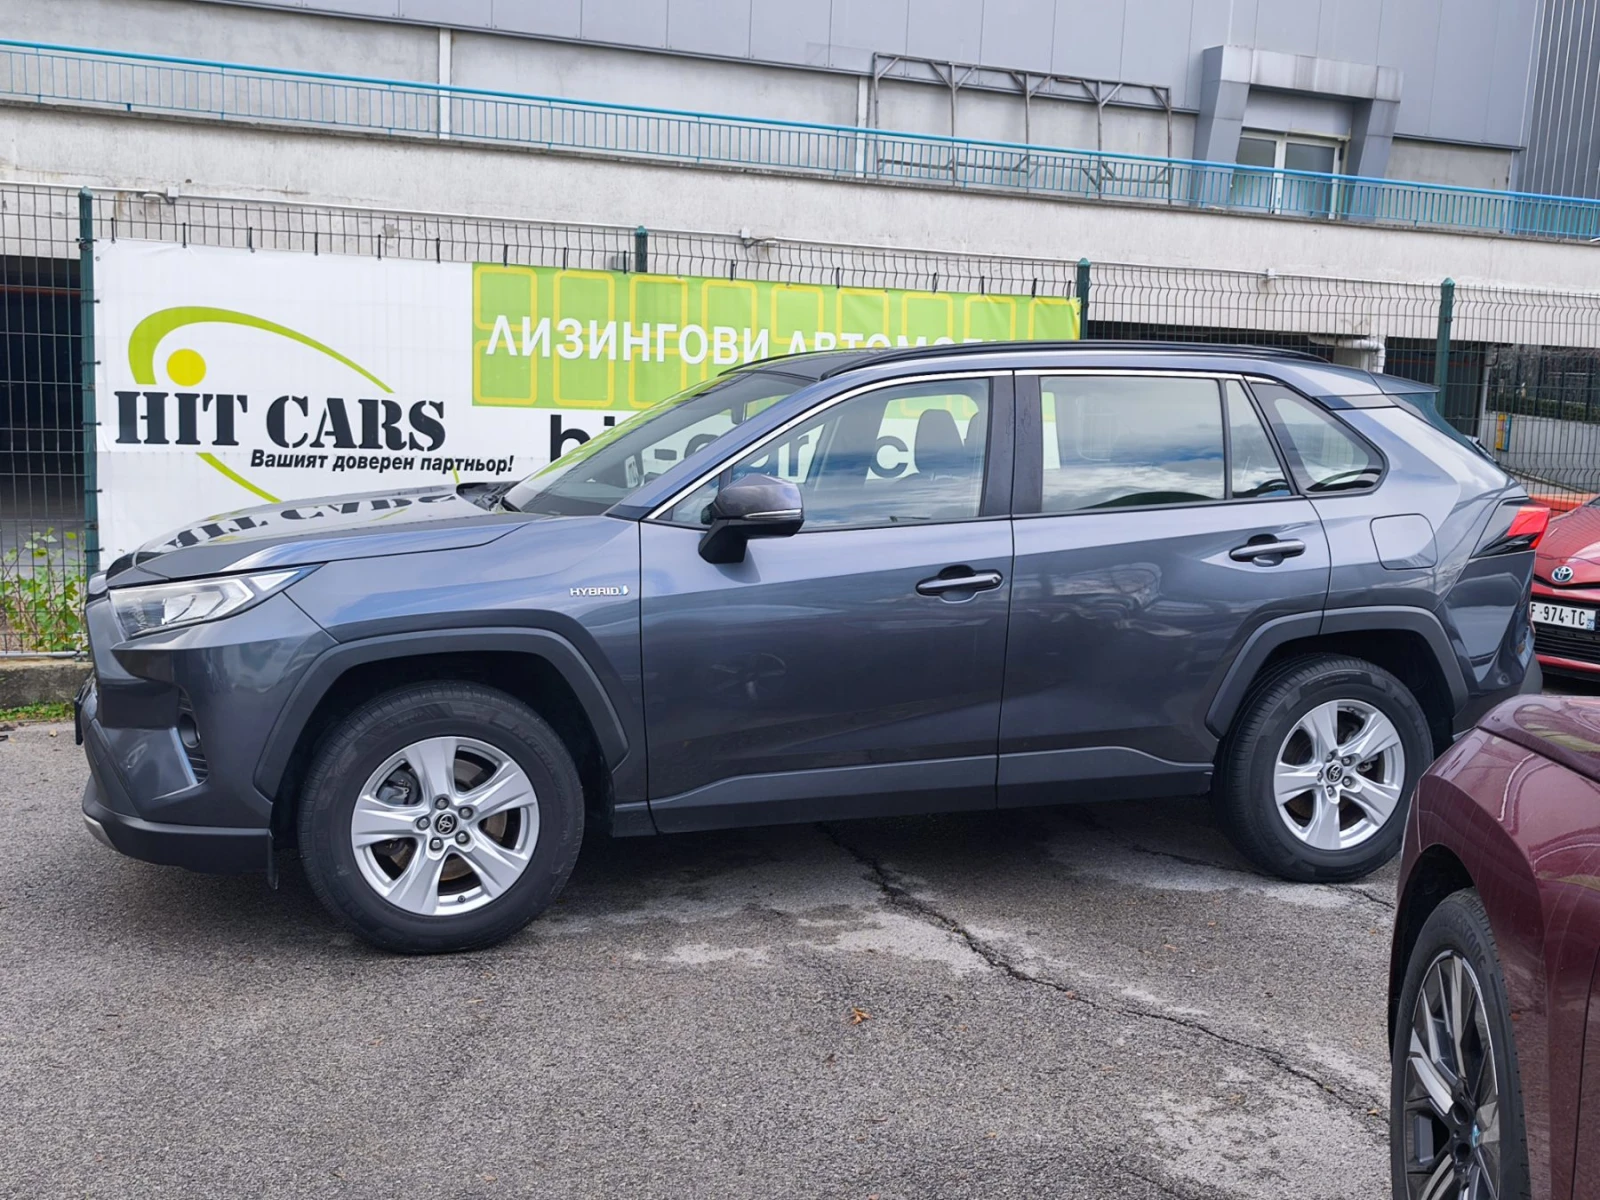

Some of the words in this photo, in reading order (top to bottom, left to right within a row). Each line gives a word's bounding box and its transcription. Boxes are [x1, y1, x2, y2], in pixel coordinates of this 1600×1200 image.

[486, 315, 768, 364] ЛИЗИНГОВИ
[114, 391, 248, 446] HIT
[266, 395, 446, 451] CARS
[250, 449, 328, 469] Вашият
[332, 454, 414, 474] доверен
[420, 455, 515, 476] партньор!
[569, 587, 620, 597] HYBRID
